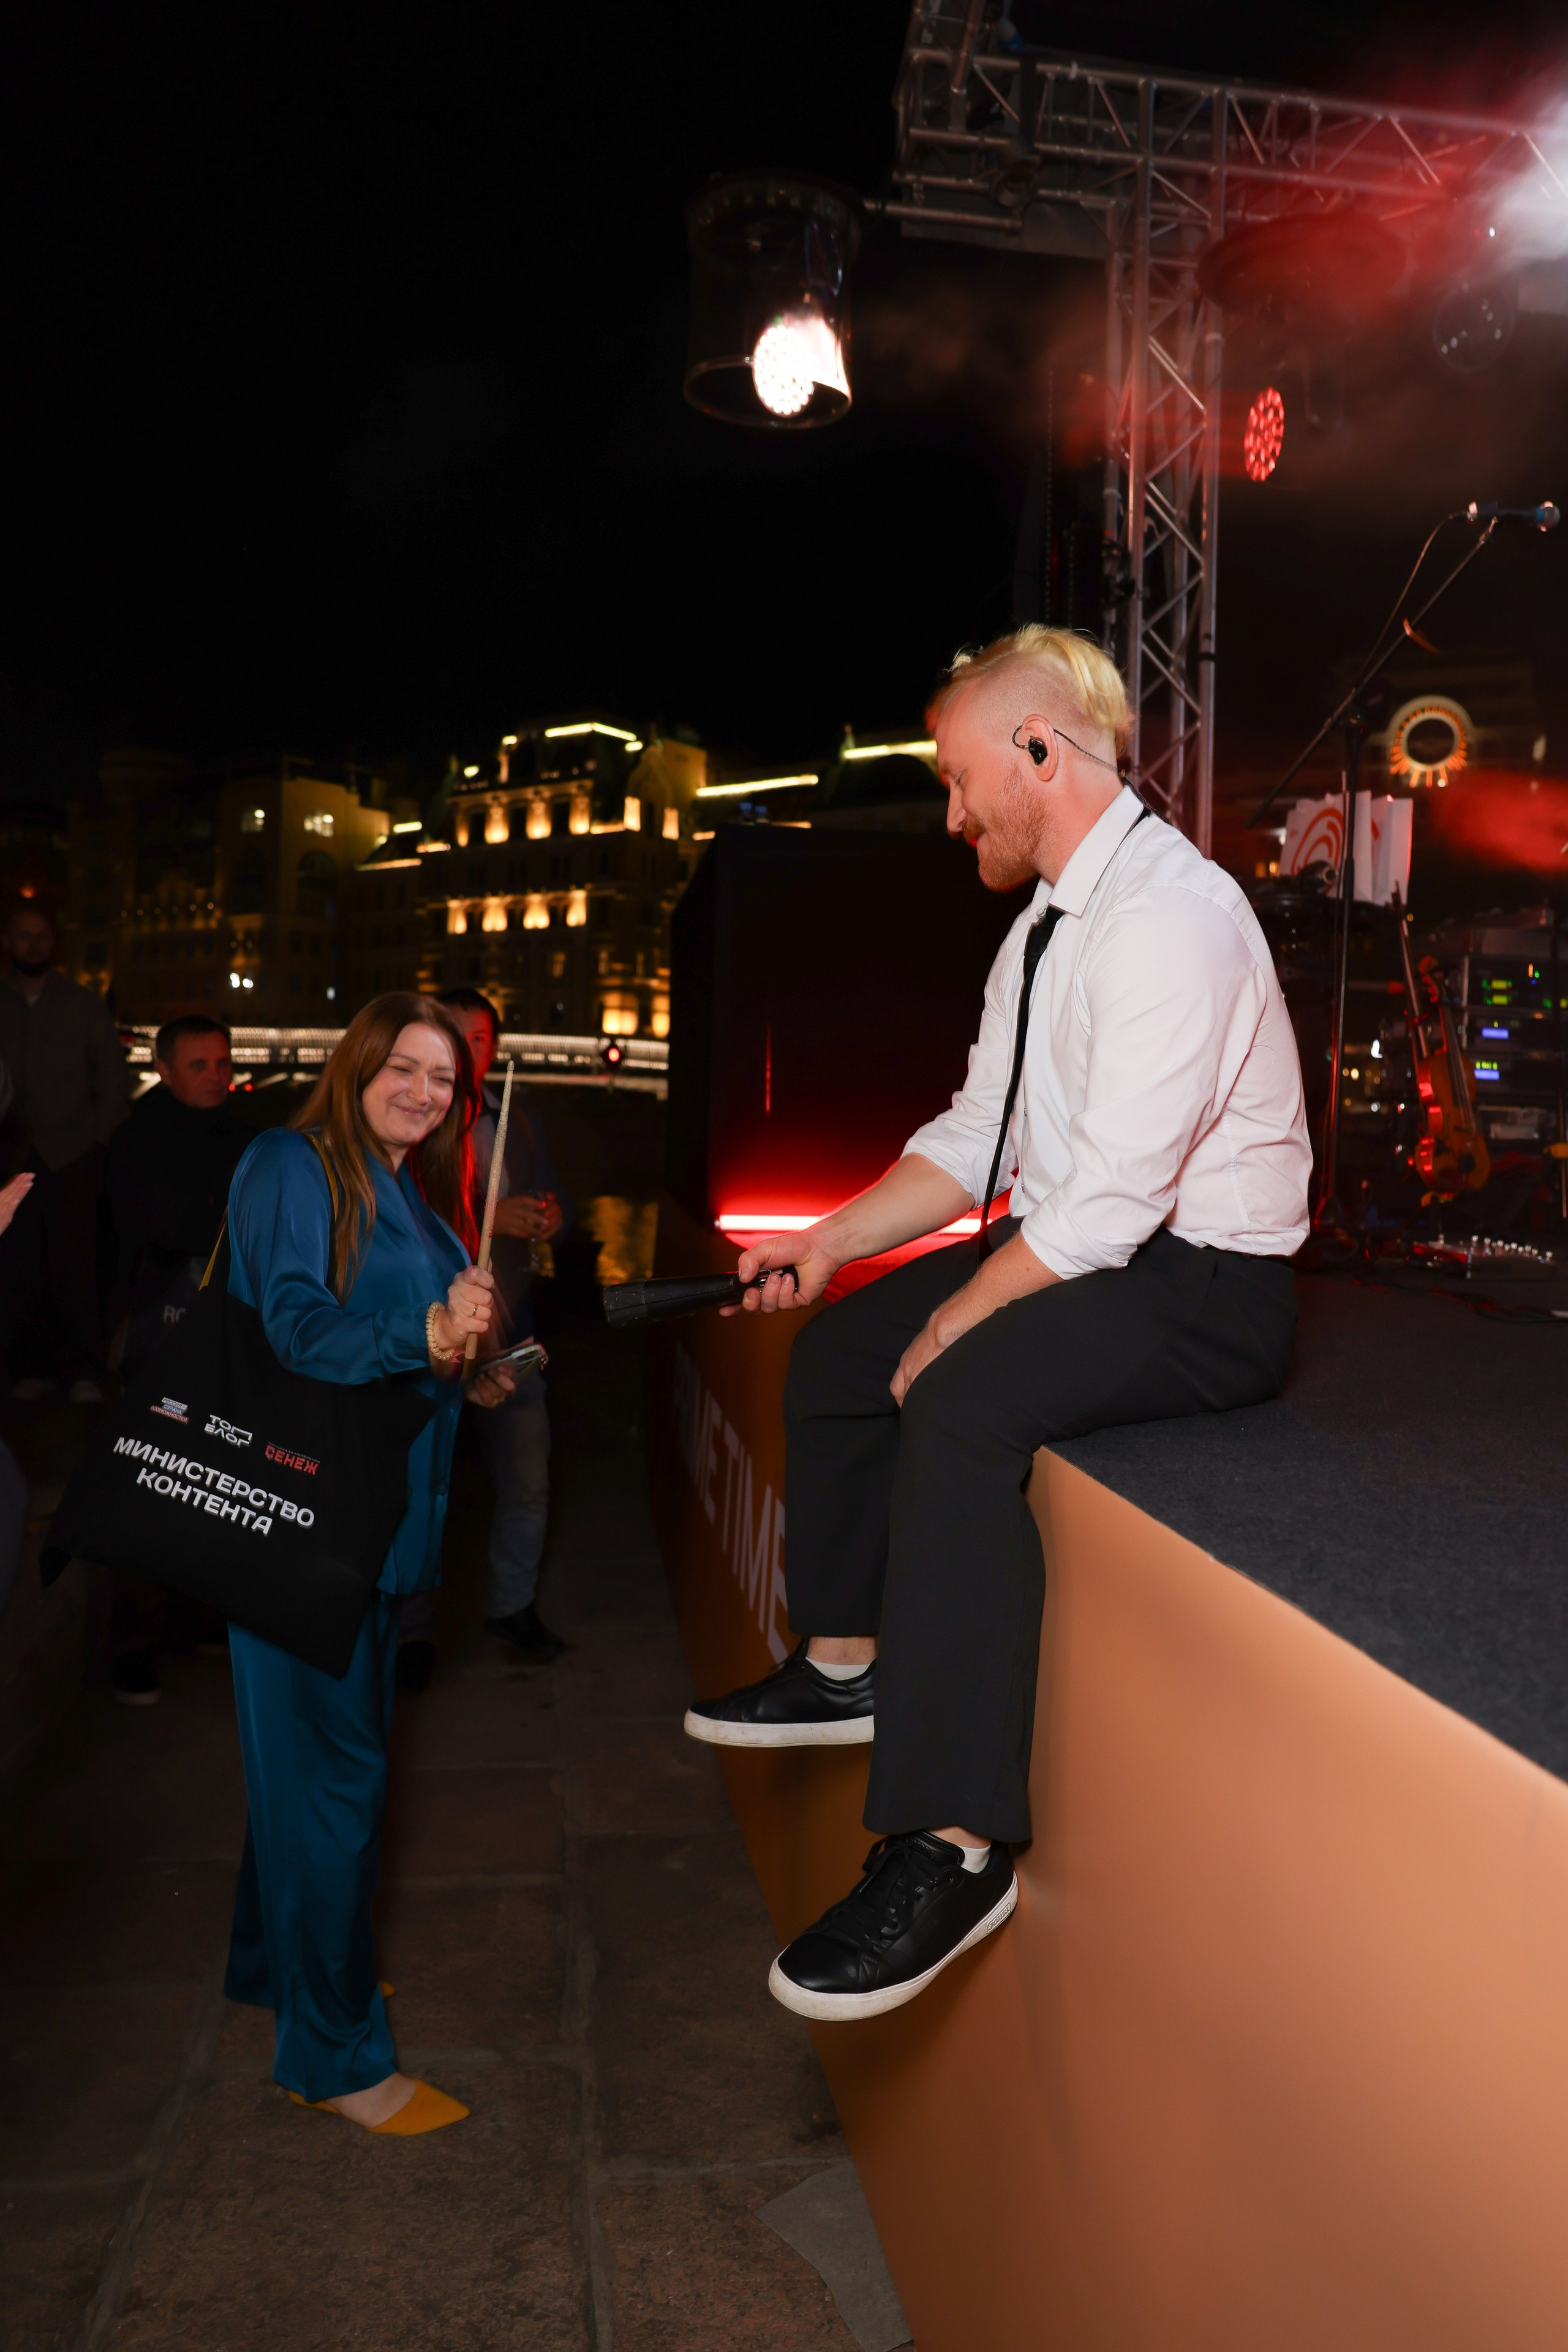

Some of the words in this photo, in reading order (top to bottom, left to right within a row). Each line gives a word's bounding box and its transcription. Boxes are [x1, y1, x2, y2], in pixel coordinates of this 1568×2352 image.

[163, 1398, 183, 1408] РОССИЯ
[164, 1404, 182, 1414] СТРАНА
[204, 1423, 250, 1446] БЛОГ
[209, 1414, 253, 1441] ТОП
[265, 1444, 318, 1475] СЕНЕЖ
[113, 1437, 315, 1528] МИНИСТЕРСТВО
[136, 1468, 273, 1536] КОНТЕНТА
